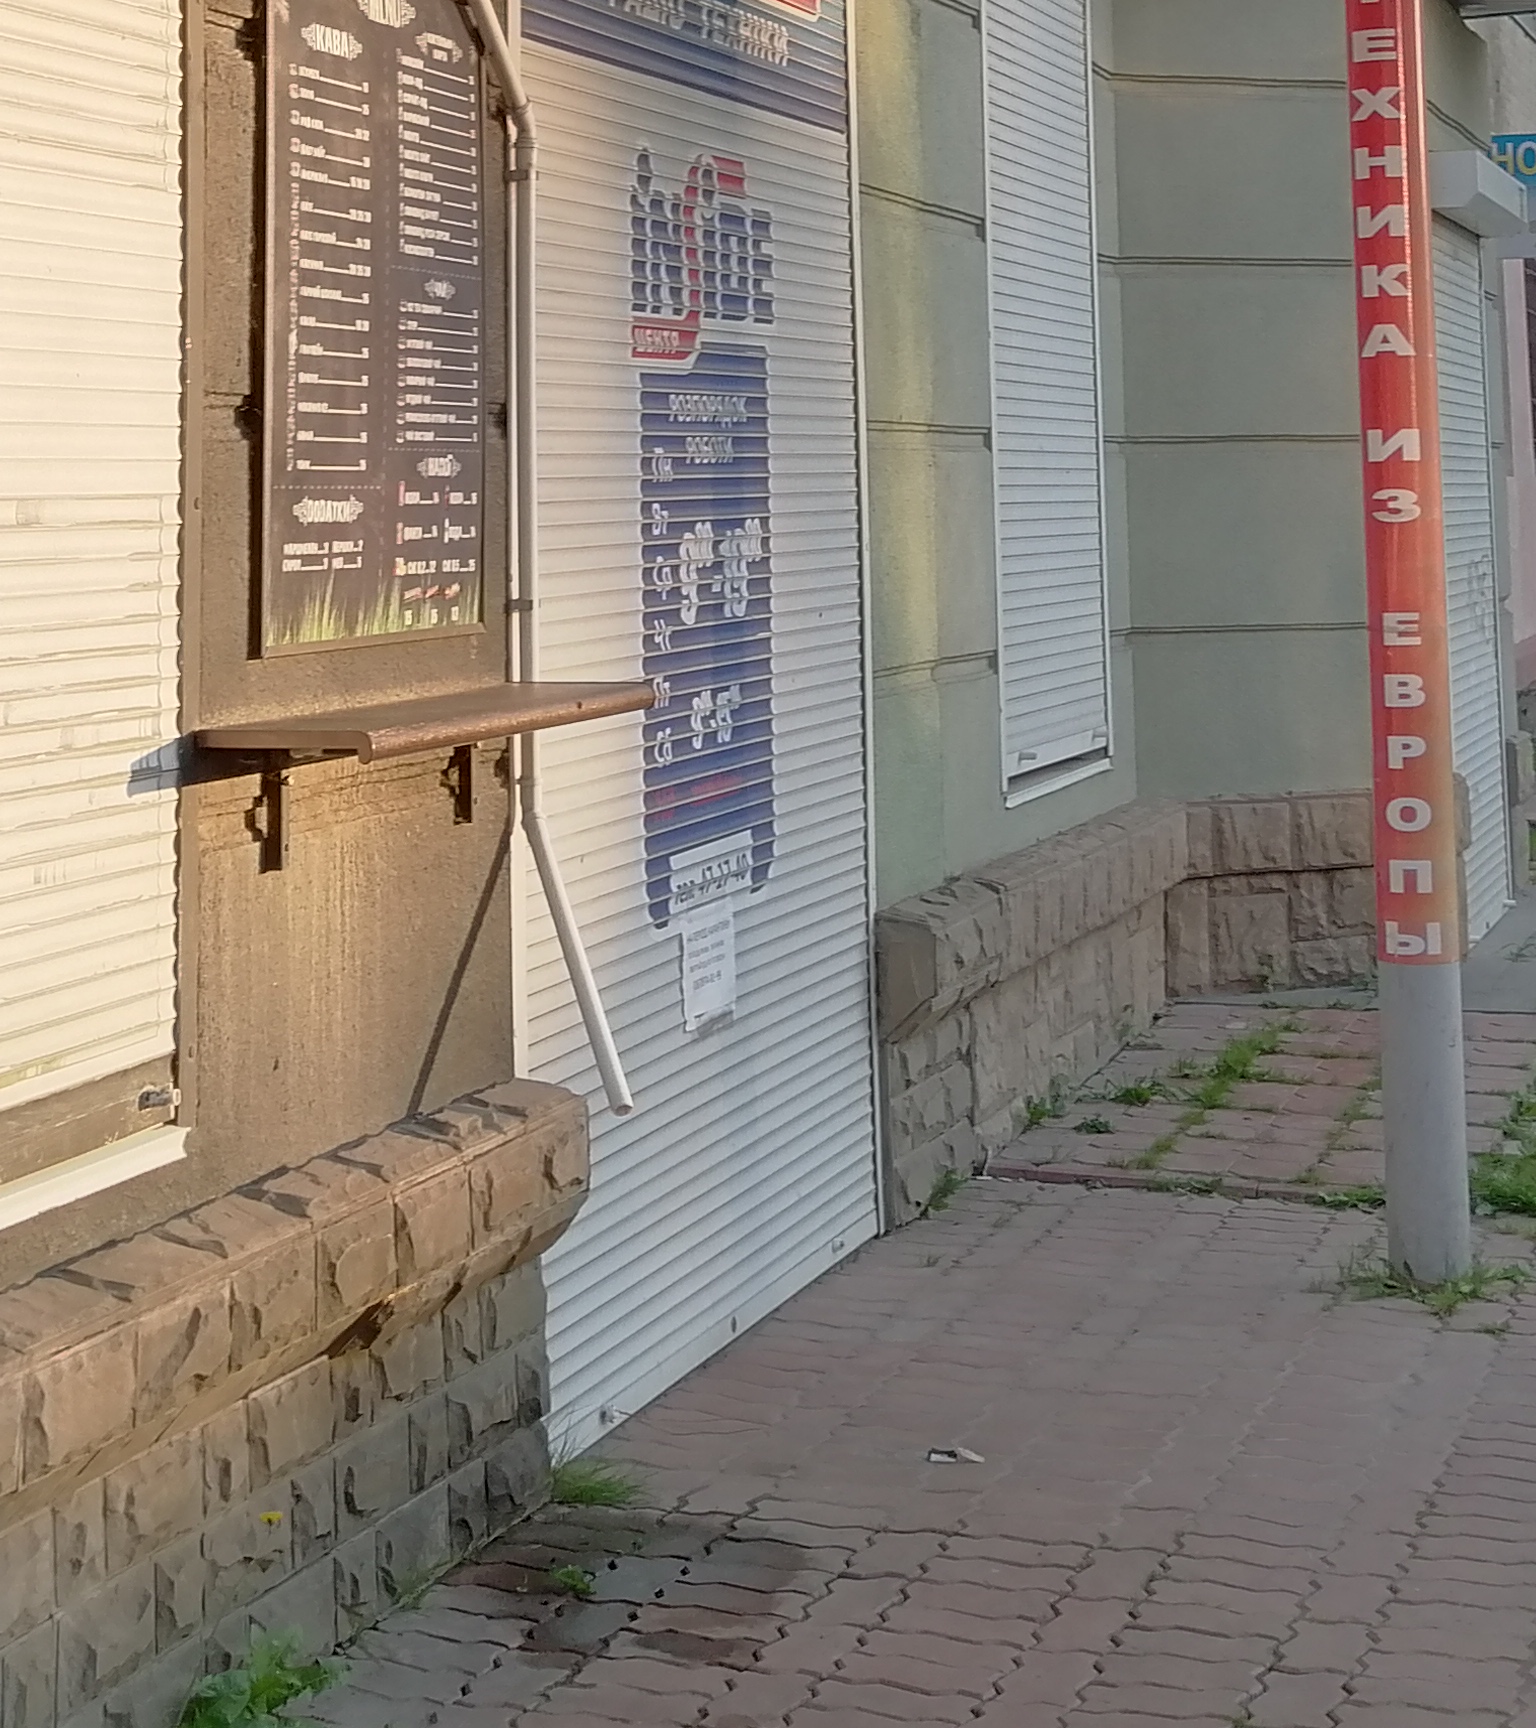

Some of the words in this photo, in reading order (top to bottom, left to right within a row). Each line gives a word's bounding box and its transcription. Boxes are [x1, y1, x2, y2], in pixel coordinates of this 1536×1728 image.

[667, 393, 749, 429] РОЗПОРЯДОК
[684, 435, 735, 465] РОБОТИ
[1367, 428, 1423, 524] ИЗ
[1381, 611, 1442, 957] ЕВРОПЫ
